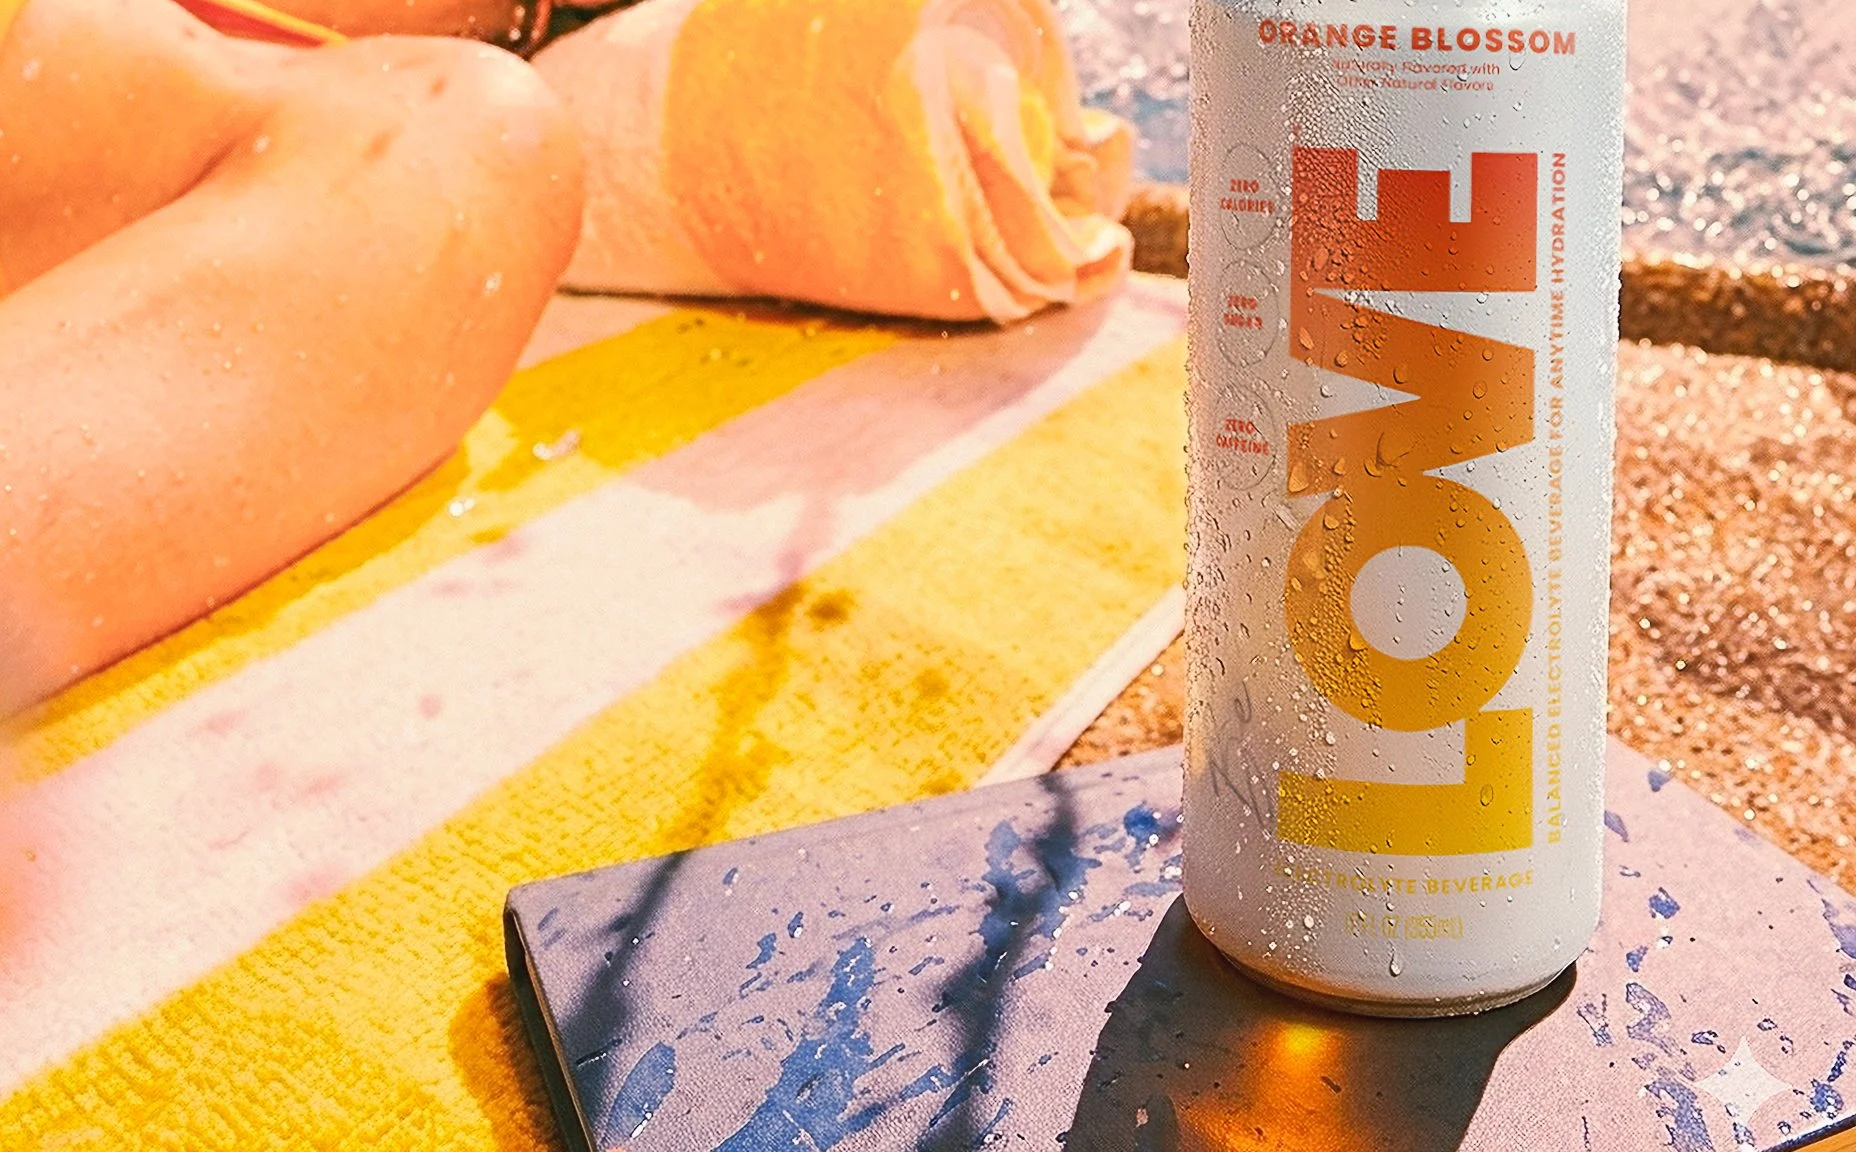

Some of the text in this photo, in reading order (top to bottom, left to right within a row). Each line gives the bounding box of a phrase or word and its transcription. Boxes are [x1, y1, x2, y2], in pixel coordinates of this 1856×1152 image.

[1258, 19, 1576, 56] ORANGE BLOSSOM
[1382, 77, 1437, 91] Natural
[1470, 62, 1500, 75] with
[1276, 147, 1538, 857] LOVE
[1547, 152, 1566, 845] BALANCED ELECTROLYTE BEVERAGE FOR ANYTIME HYDRATION
[1273, 860, 1534, 895] EECTROLYTE BEVERAGE
